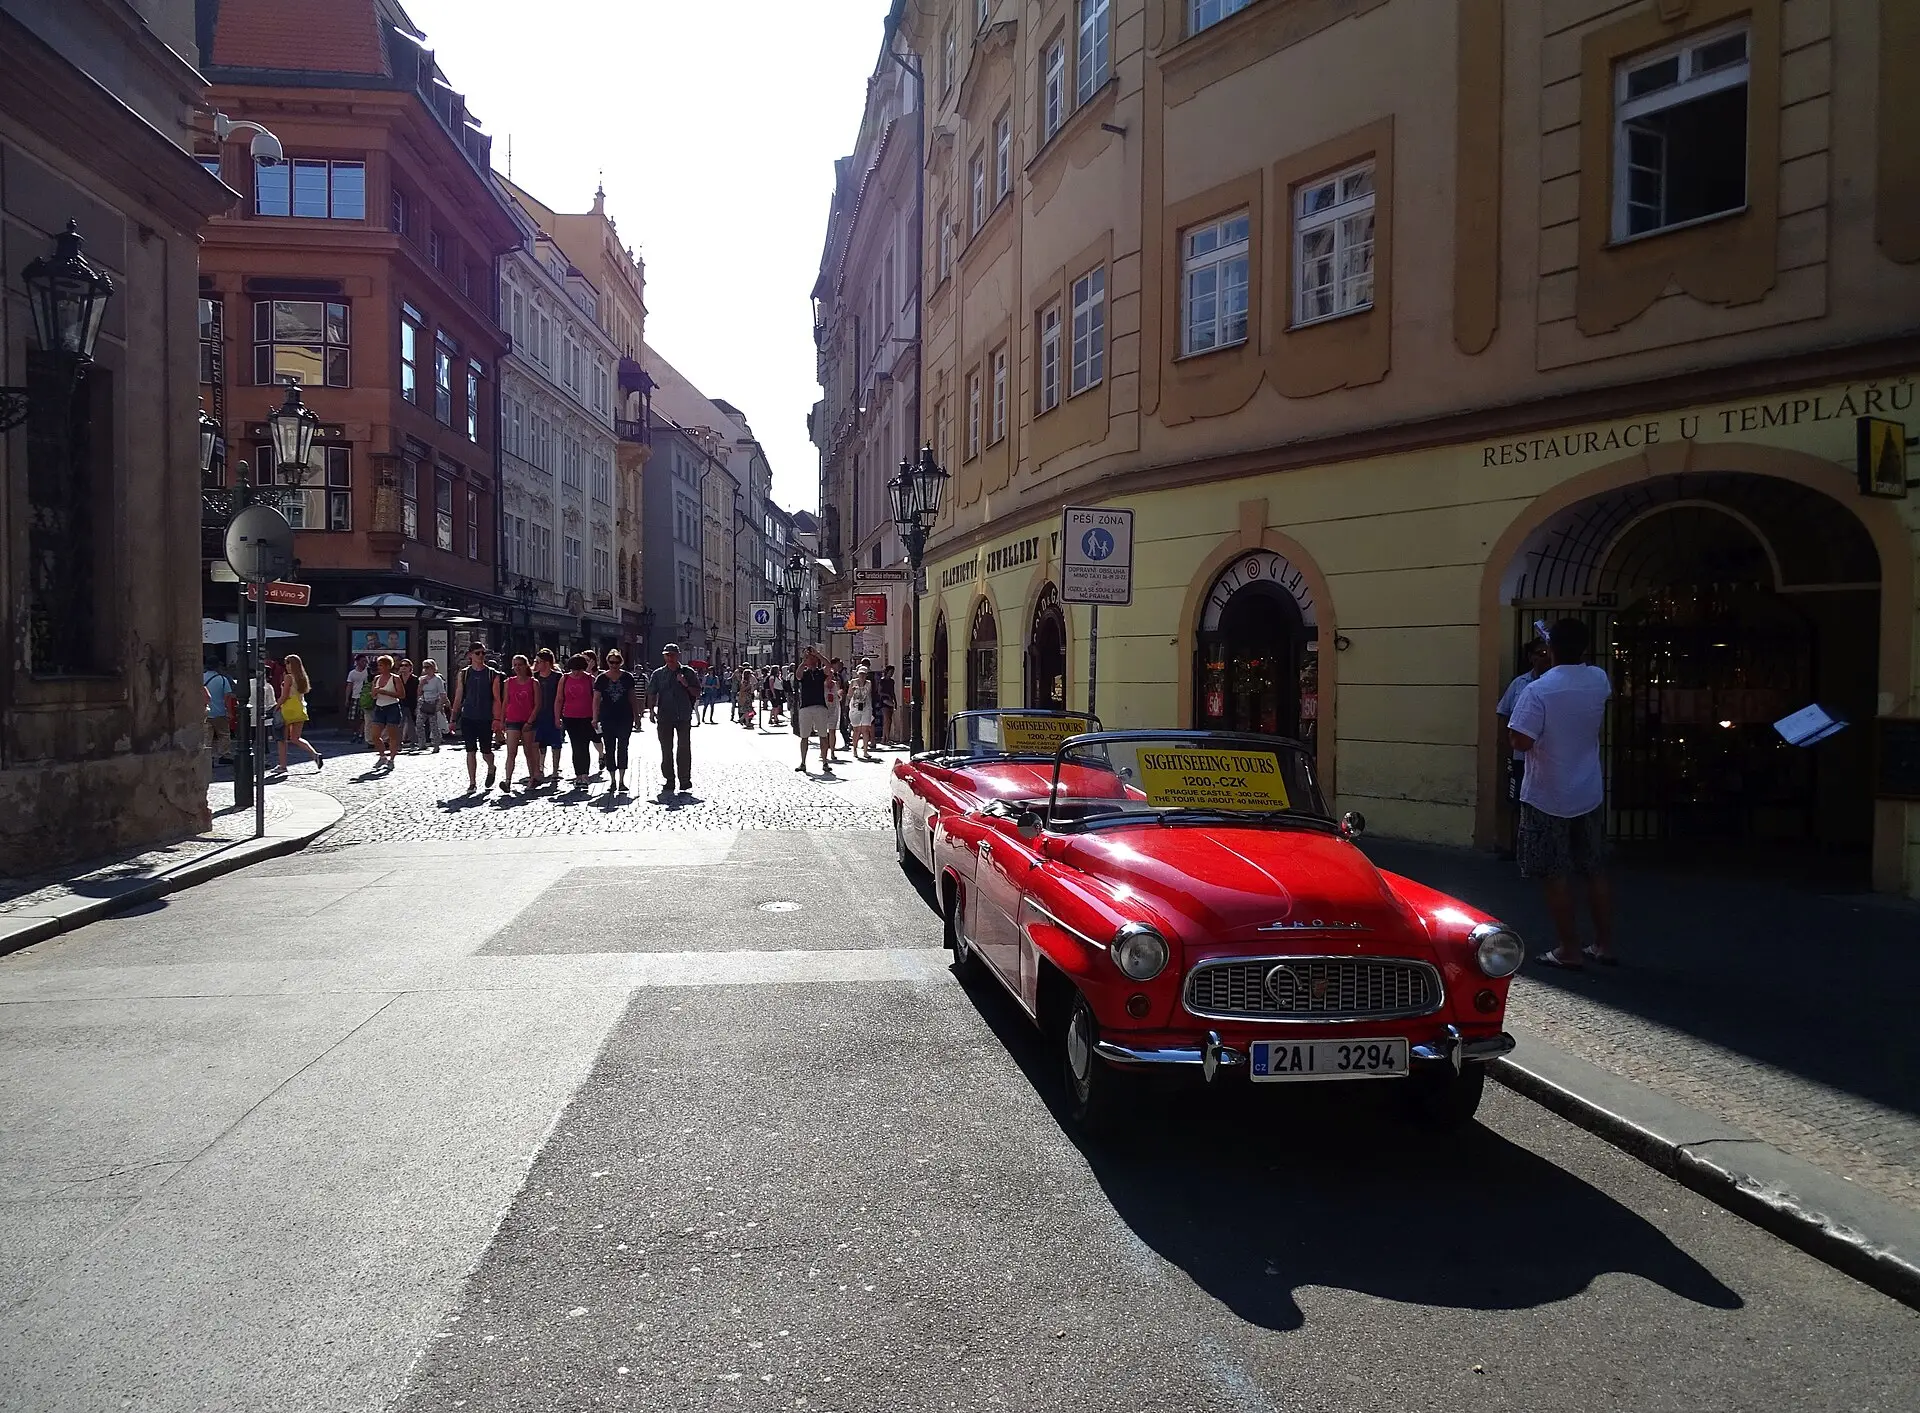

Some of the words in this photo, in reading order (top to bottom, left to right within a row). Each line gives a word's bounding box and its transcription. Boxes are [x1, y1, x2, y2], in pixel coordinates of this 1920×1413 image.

[1482, 421, 1661, 468] RESTAURACE
[1680, 415, 1699, 440] U
[1718, 378, 1916, 434] TEMPLÁŘŮ
[1073, 514, 1094, 524] PĚŠÍ
[1098, 515, 1124, 525] ZÓNA
[986, 536, 1040, 574] JEWELLERY
[1212, 567, 1241, 611] ART
[1269, 556, 1313, 611] GLASS
[270, 588, 278, 597] di
[279, 590, 296, 599] Vino
[1006, 720, 1057, 731] SIGHTSEEING
[1058, 722, 1084, 733] TOURS
[1144, 753, 1230, 773] SIGHTSEEING
[1231, 756, 1275, 774] TOURS
[1182, 776, 1248, 788] 1200,-CZK
[1164, 788, 1199, 796] PRAGUE
[1200, 789, 1232, 798] CASTLE
[1248, 799, 1285, 807] MINUTES
[1273, 1046, 1315, 1072] 2AI
[1337, 1044, 1396, 1071] 3294
[1255, 1063, 1267, 1071] CZ
